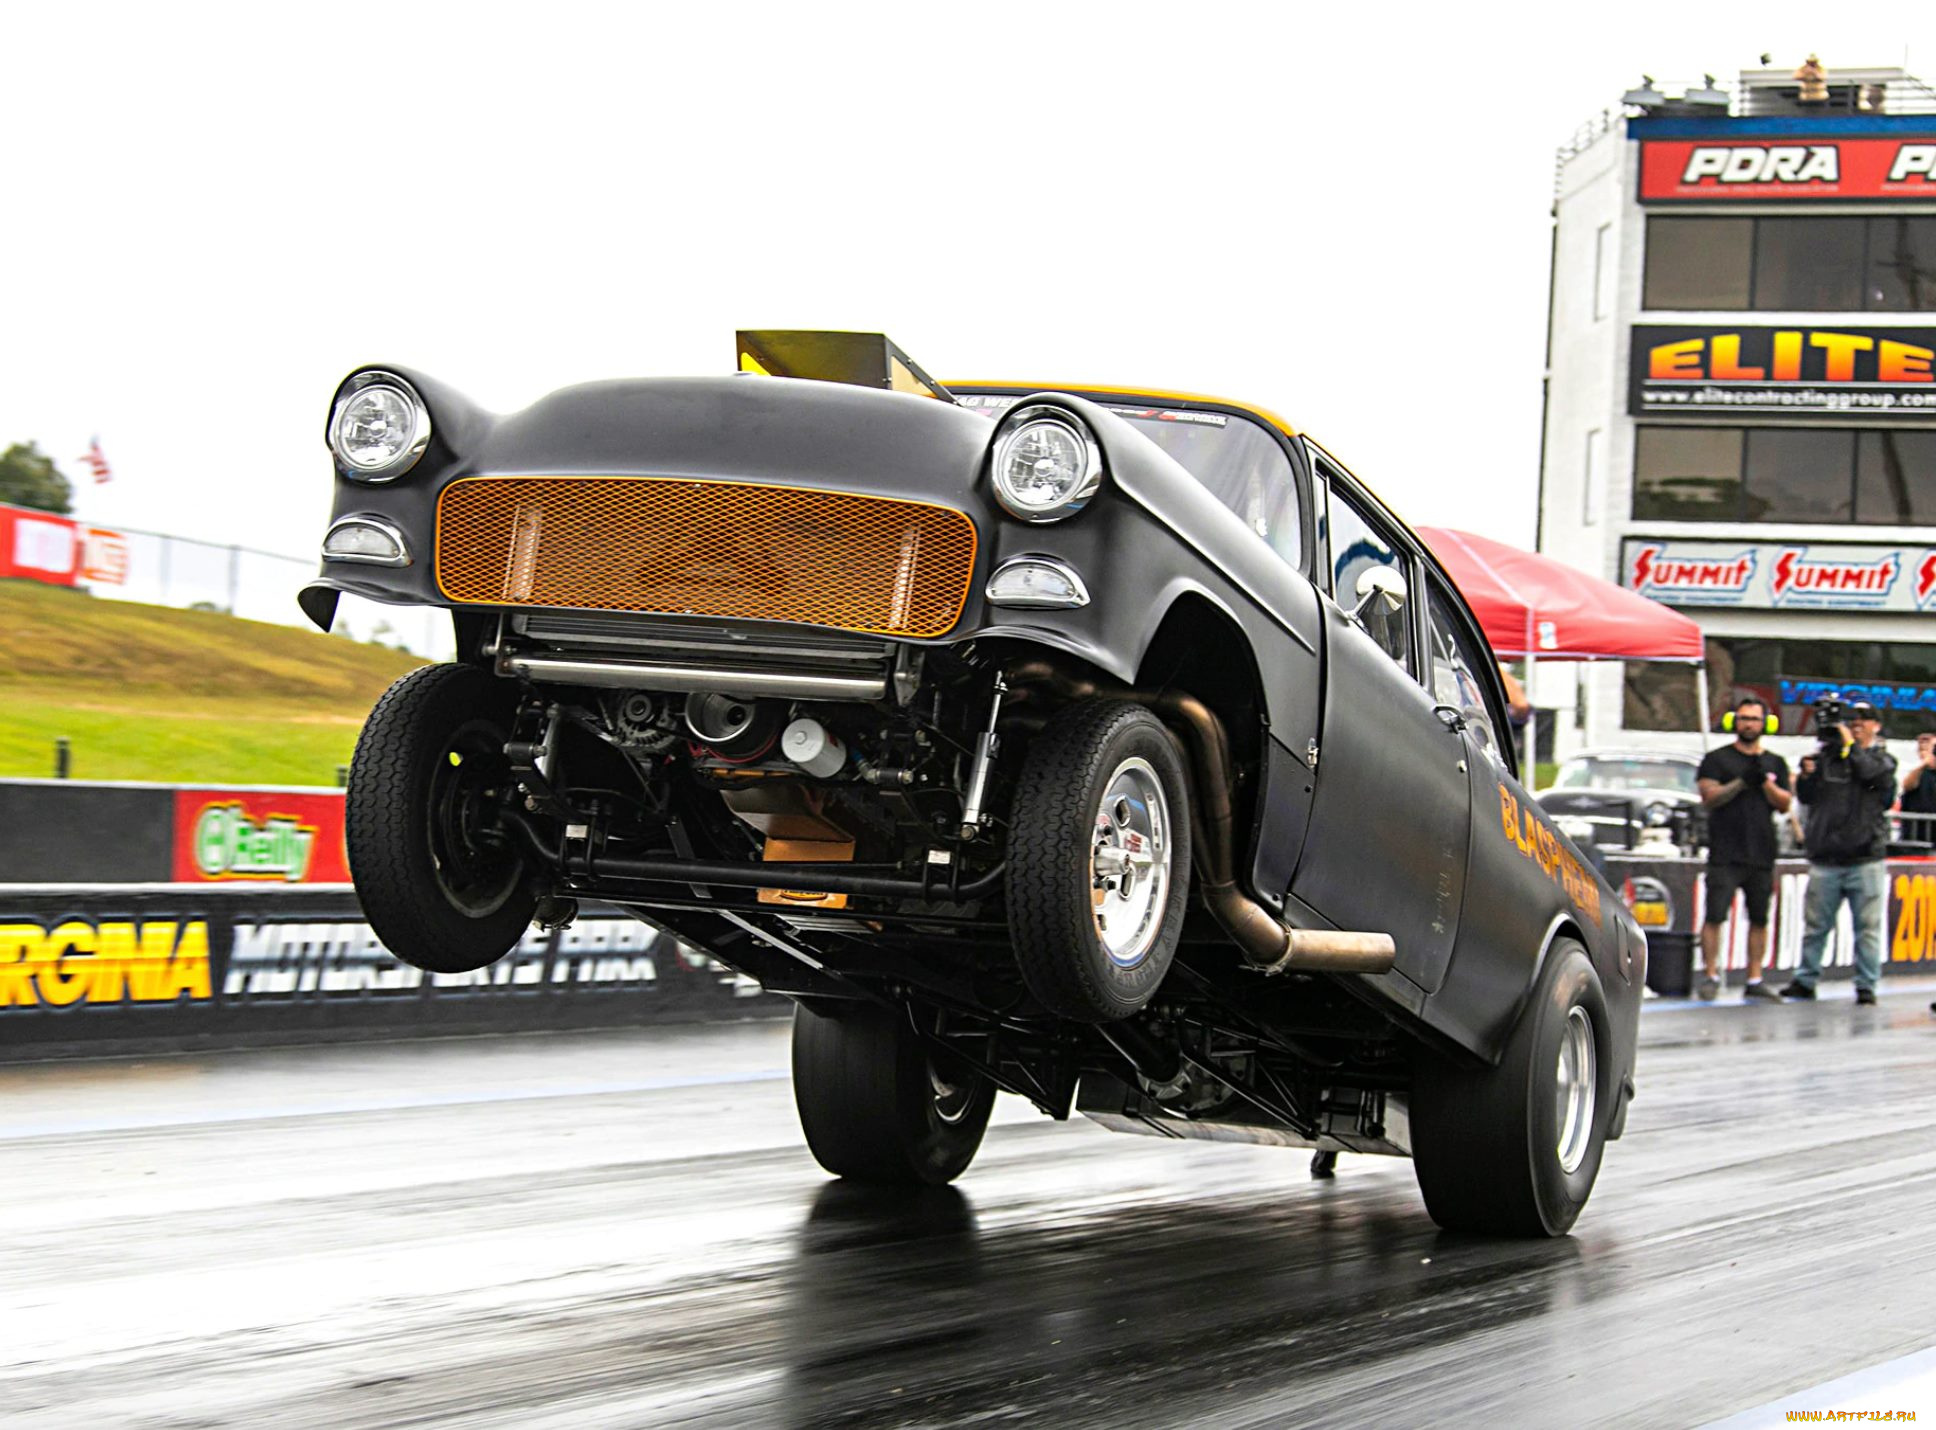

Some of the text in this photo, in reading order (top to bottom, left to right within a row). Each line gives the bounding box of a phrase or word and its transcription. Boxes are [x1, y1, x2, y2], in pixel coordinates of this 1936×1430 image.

[1683, 146, 1838, 182] PDRA
[1888, 146, 1936, 181] P
[1649, 331, 1935, 382] ELITE
